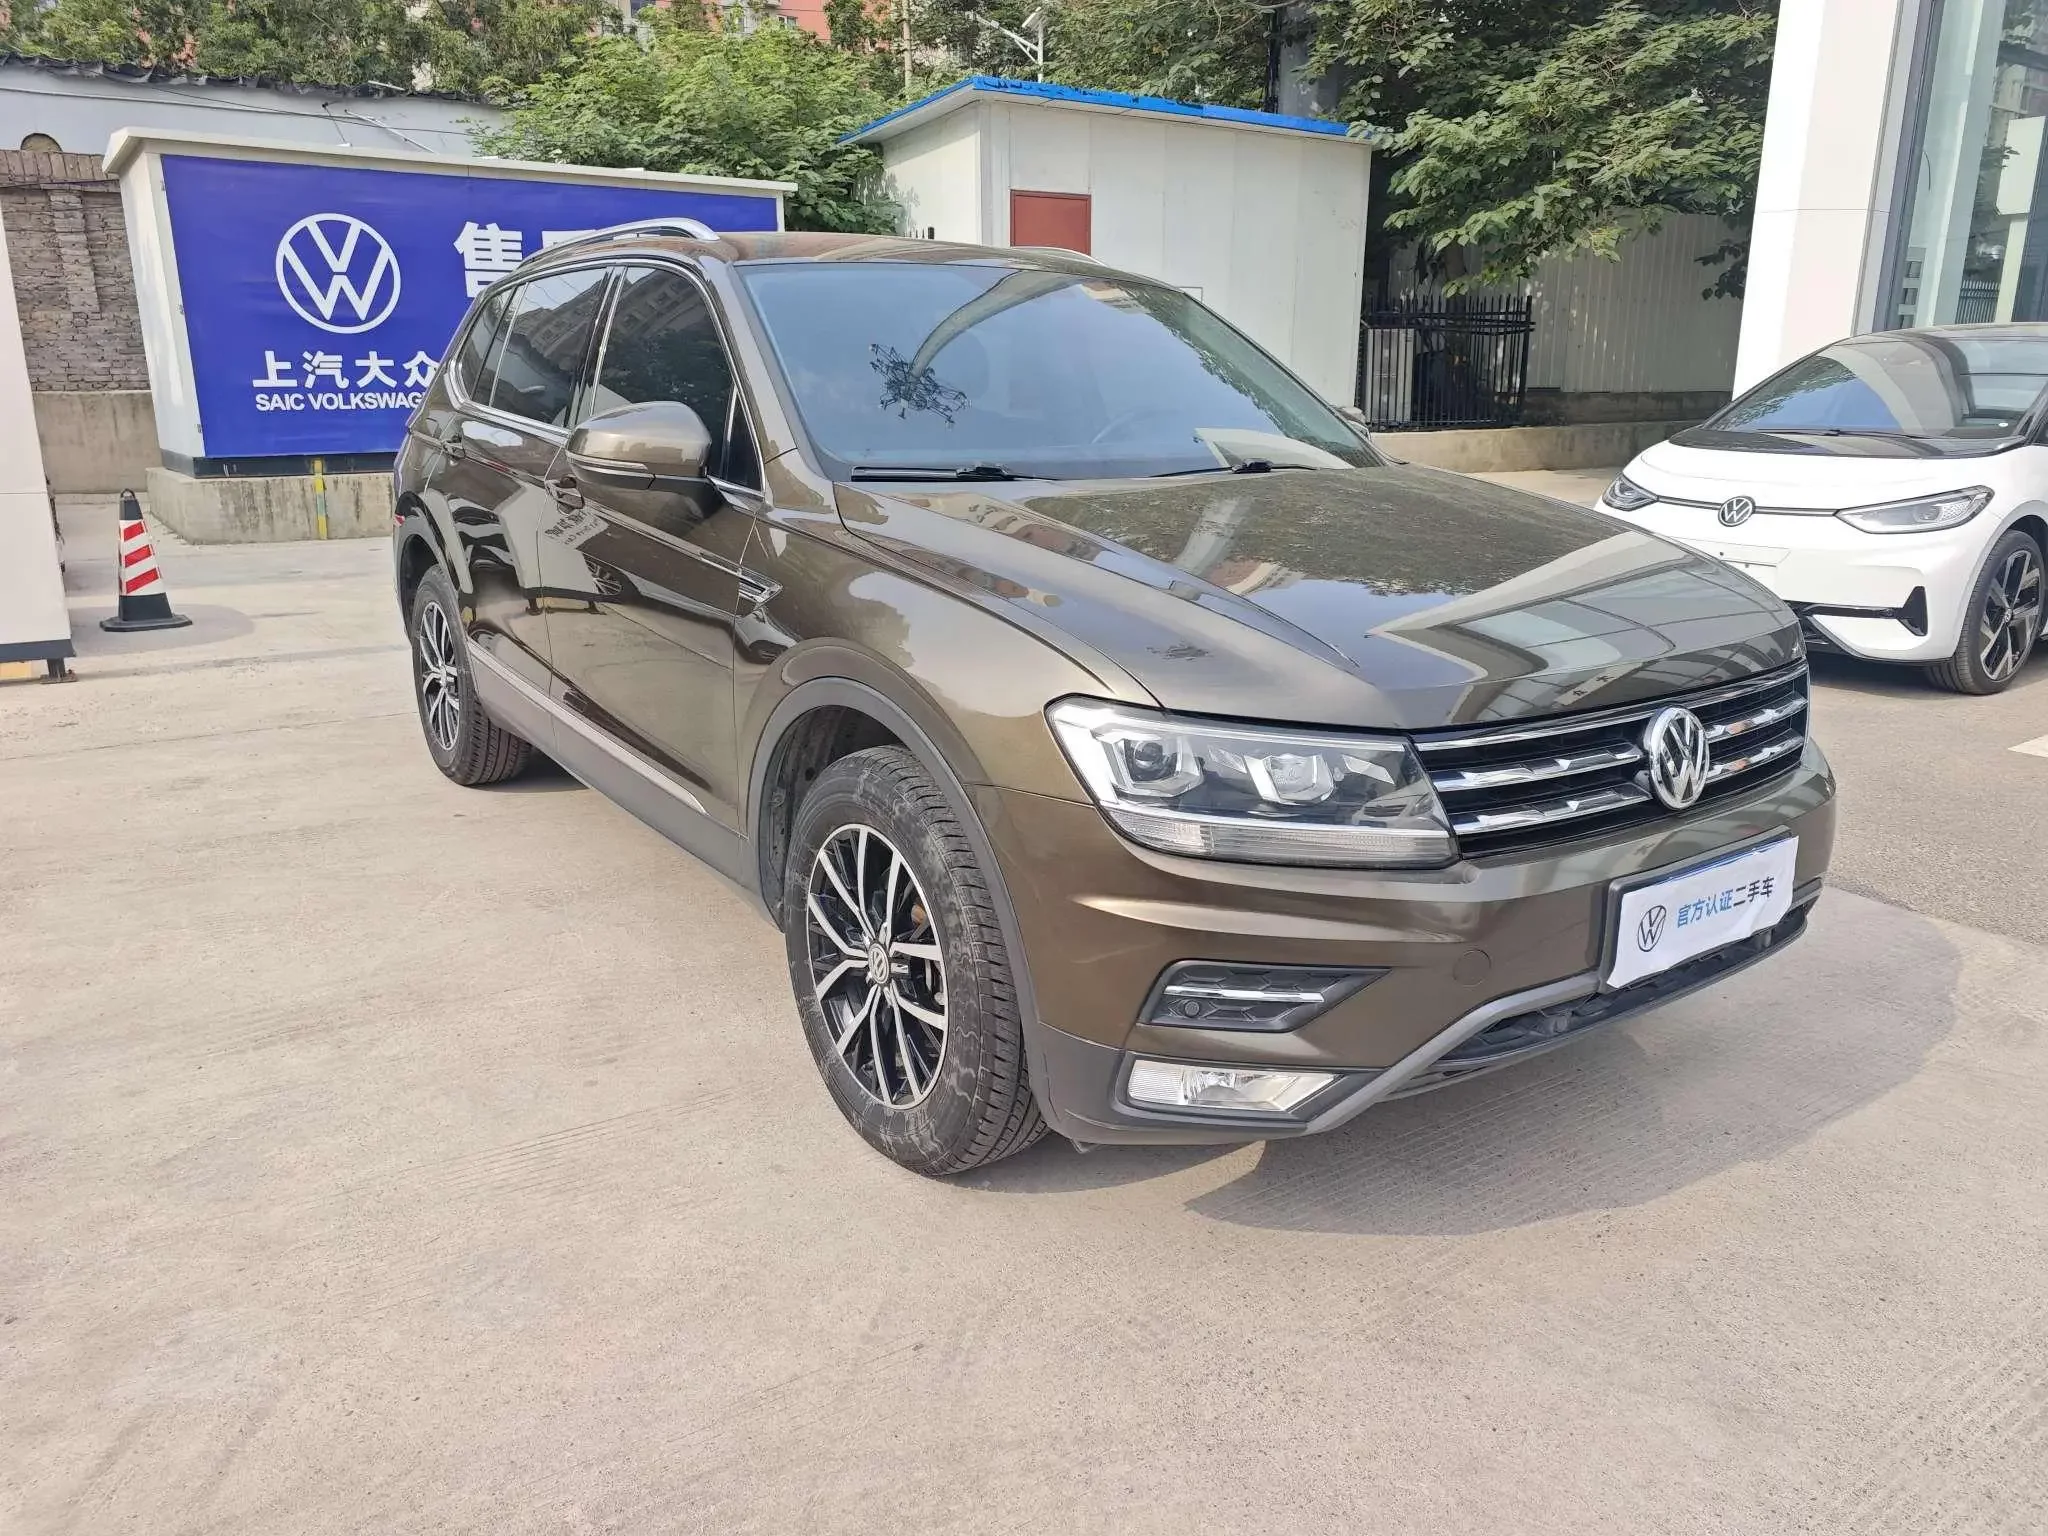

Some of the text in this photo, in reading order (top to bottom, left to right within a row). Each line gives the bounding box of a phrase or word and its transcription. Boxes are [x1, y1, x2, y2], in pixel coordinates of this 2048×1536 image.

[252, 350, 440, 389] 上汽大众
[255, 391, 425, 411] SAIC VOLKSWAG
[1677, 876, 1775, 928] 官方认证二手车
